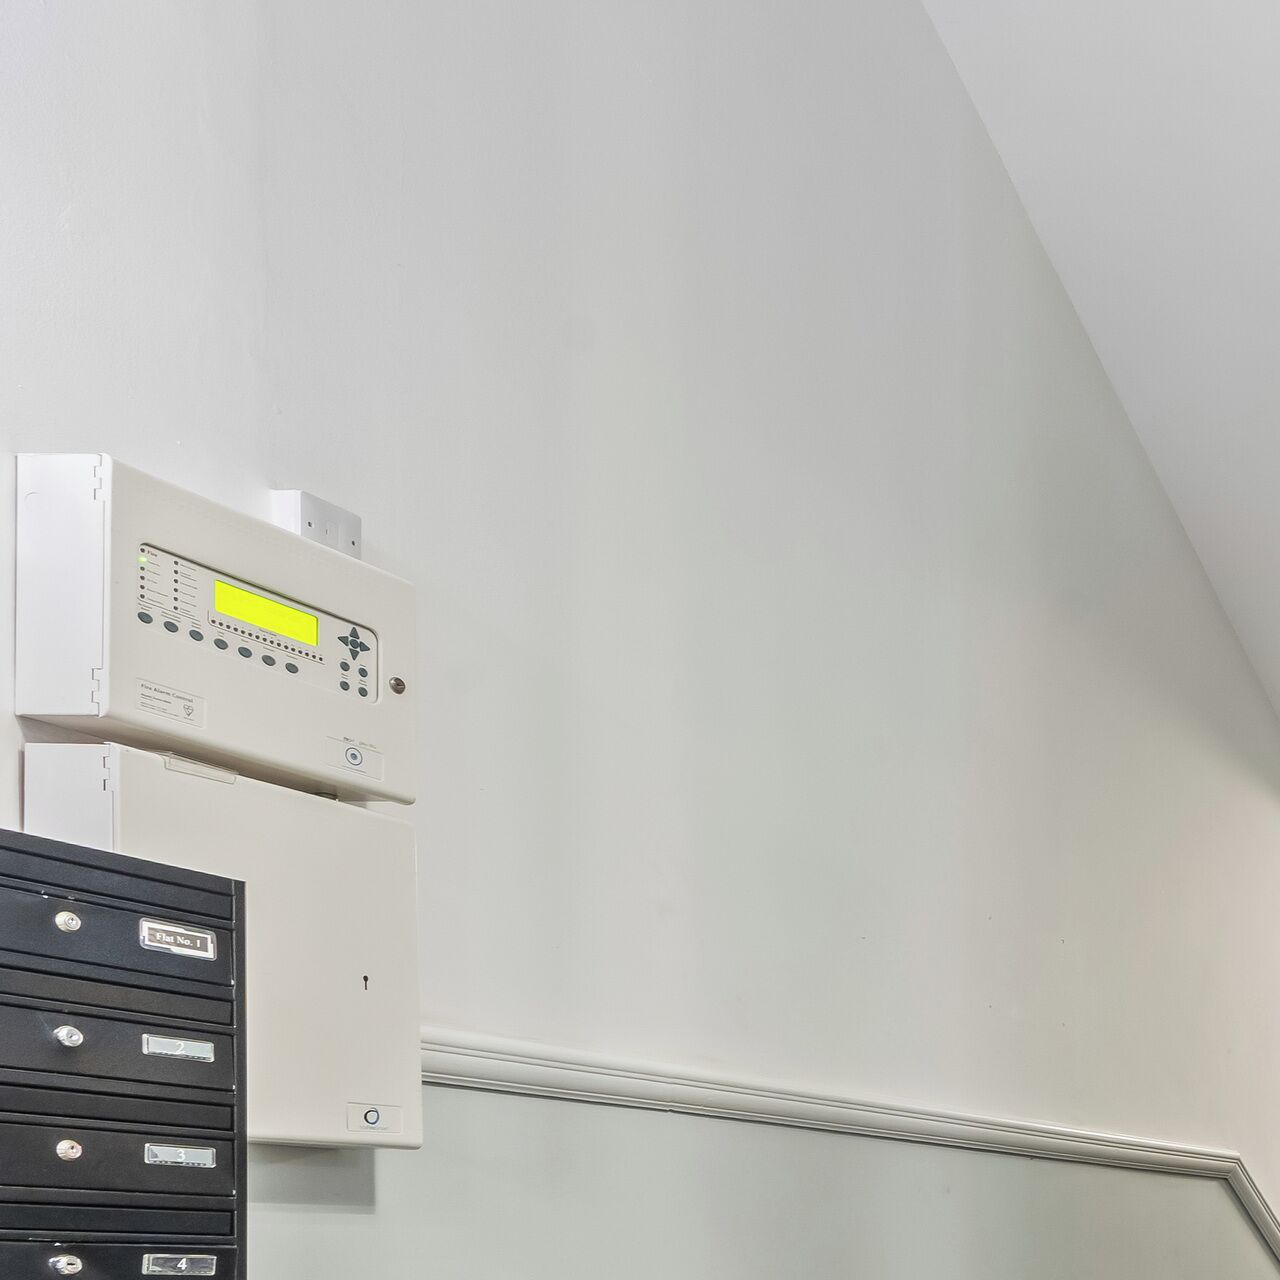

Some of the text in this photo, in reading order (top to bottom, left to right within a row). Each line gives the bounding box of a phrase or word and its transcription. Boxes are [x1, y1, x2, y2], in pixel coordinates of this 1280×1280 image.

[156, 932, 174, 943] Flat
[176, 935, 193, 946] No.
[175, 1040, 185, 1055] 2
[176, 1148, 186, 1161] 3
[177, 1257, 188, 1270] 4
